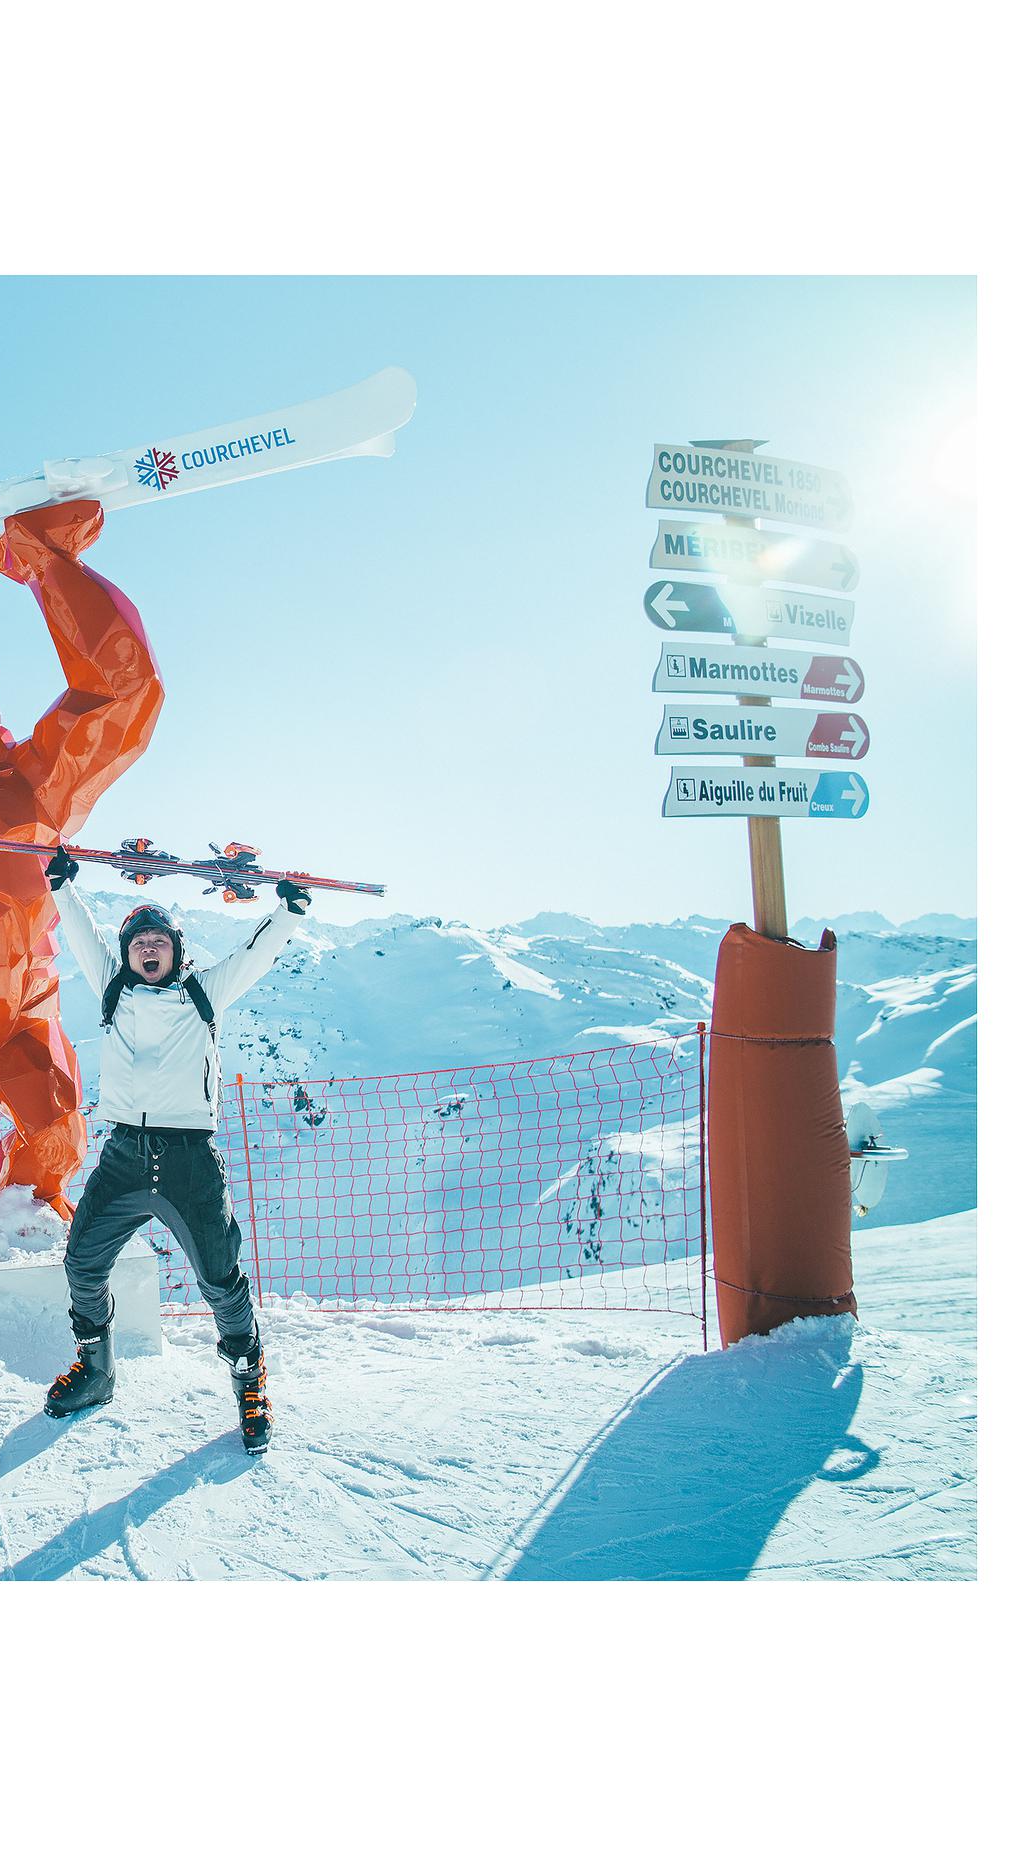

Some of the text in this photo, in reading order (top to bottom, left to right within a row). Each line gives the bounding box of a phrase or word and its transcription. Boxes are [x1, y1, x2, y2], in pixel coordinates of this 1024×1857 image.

[181, 428, 296, 470] COURCHEVEL
[658, 451, 822, 493] COURCHEVEL 1850
[660, 479, 771, 512] COURCHEVEL
[664, 531, 770, 562] MÉRIBE
[784, 603, 847, 631] Vizelle
[689, 657, 799, 684] Marmottes
[803, 683, 845, 698] Marmottes
[692, 718, 777, 741] Saulire
[808, 741, 830, 753] Combe
[699, 780, 809, 806] Aiguille du Fruit
[810, 801, 835, 812] Creux
